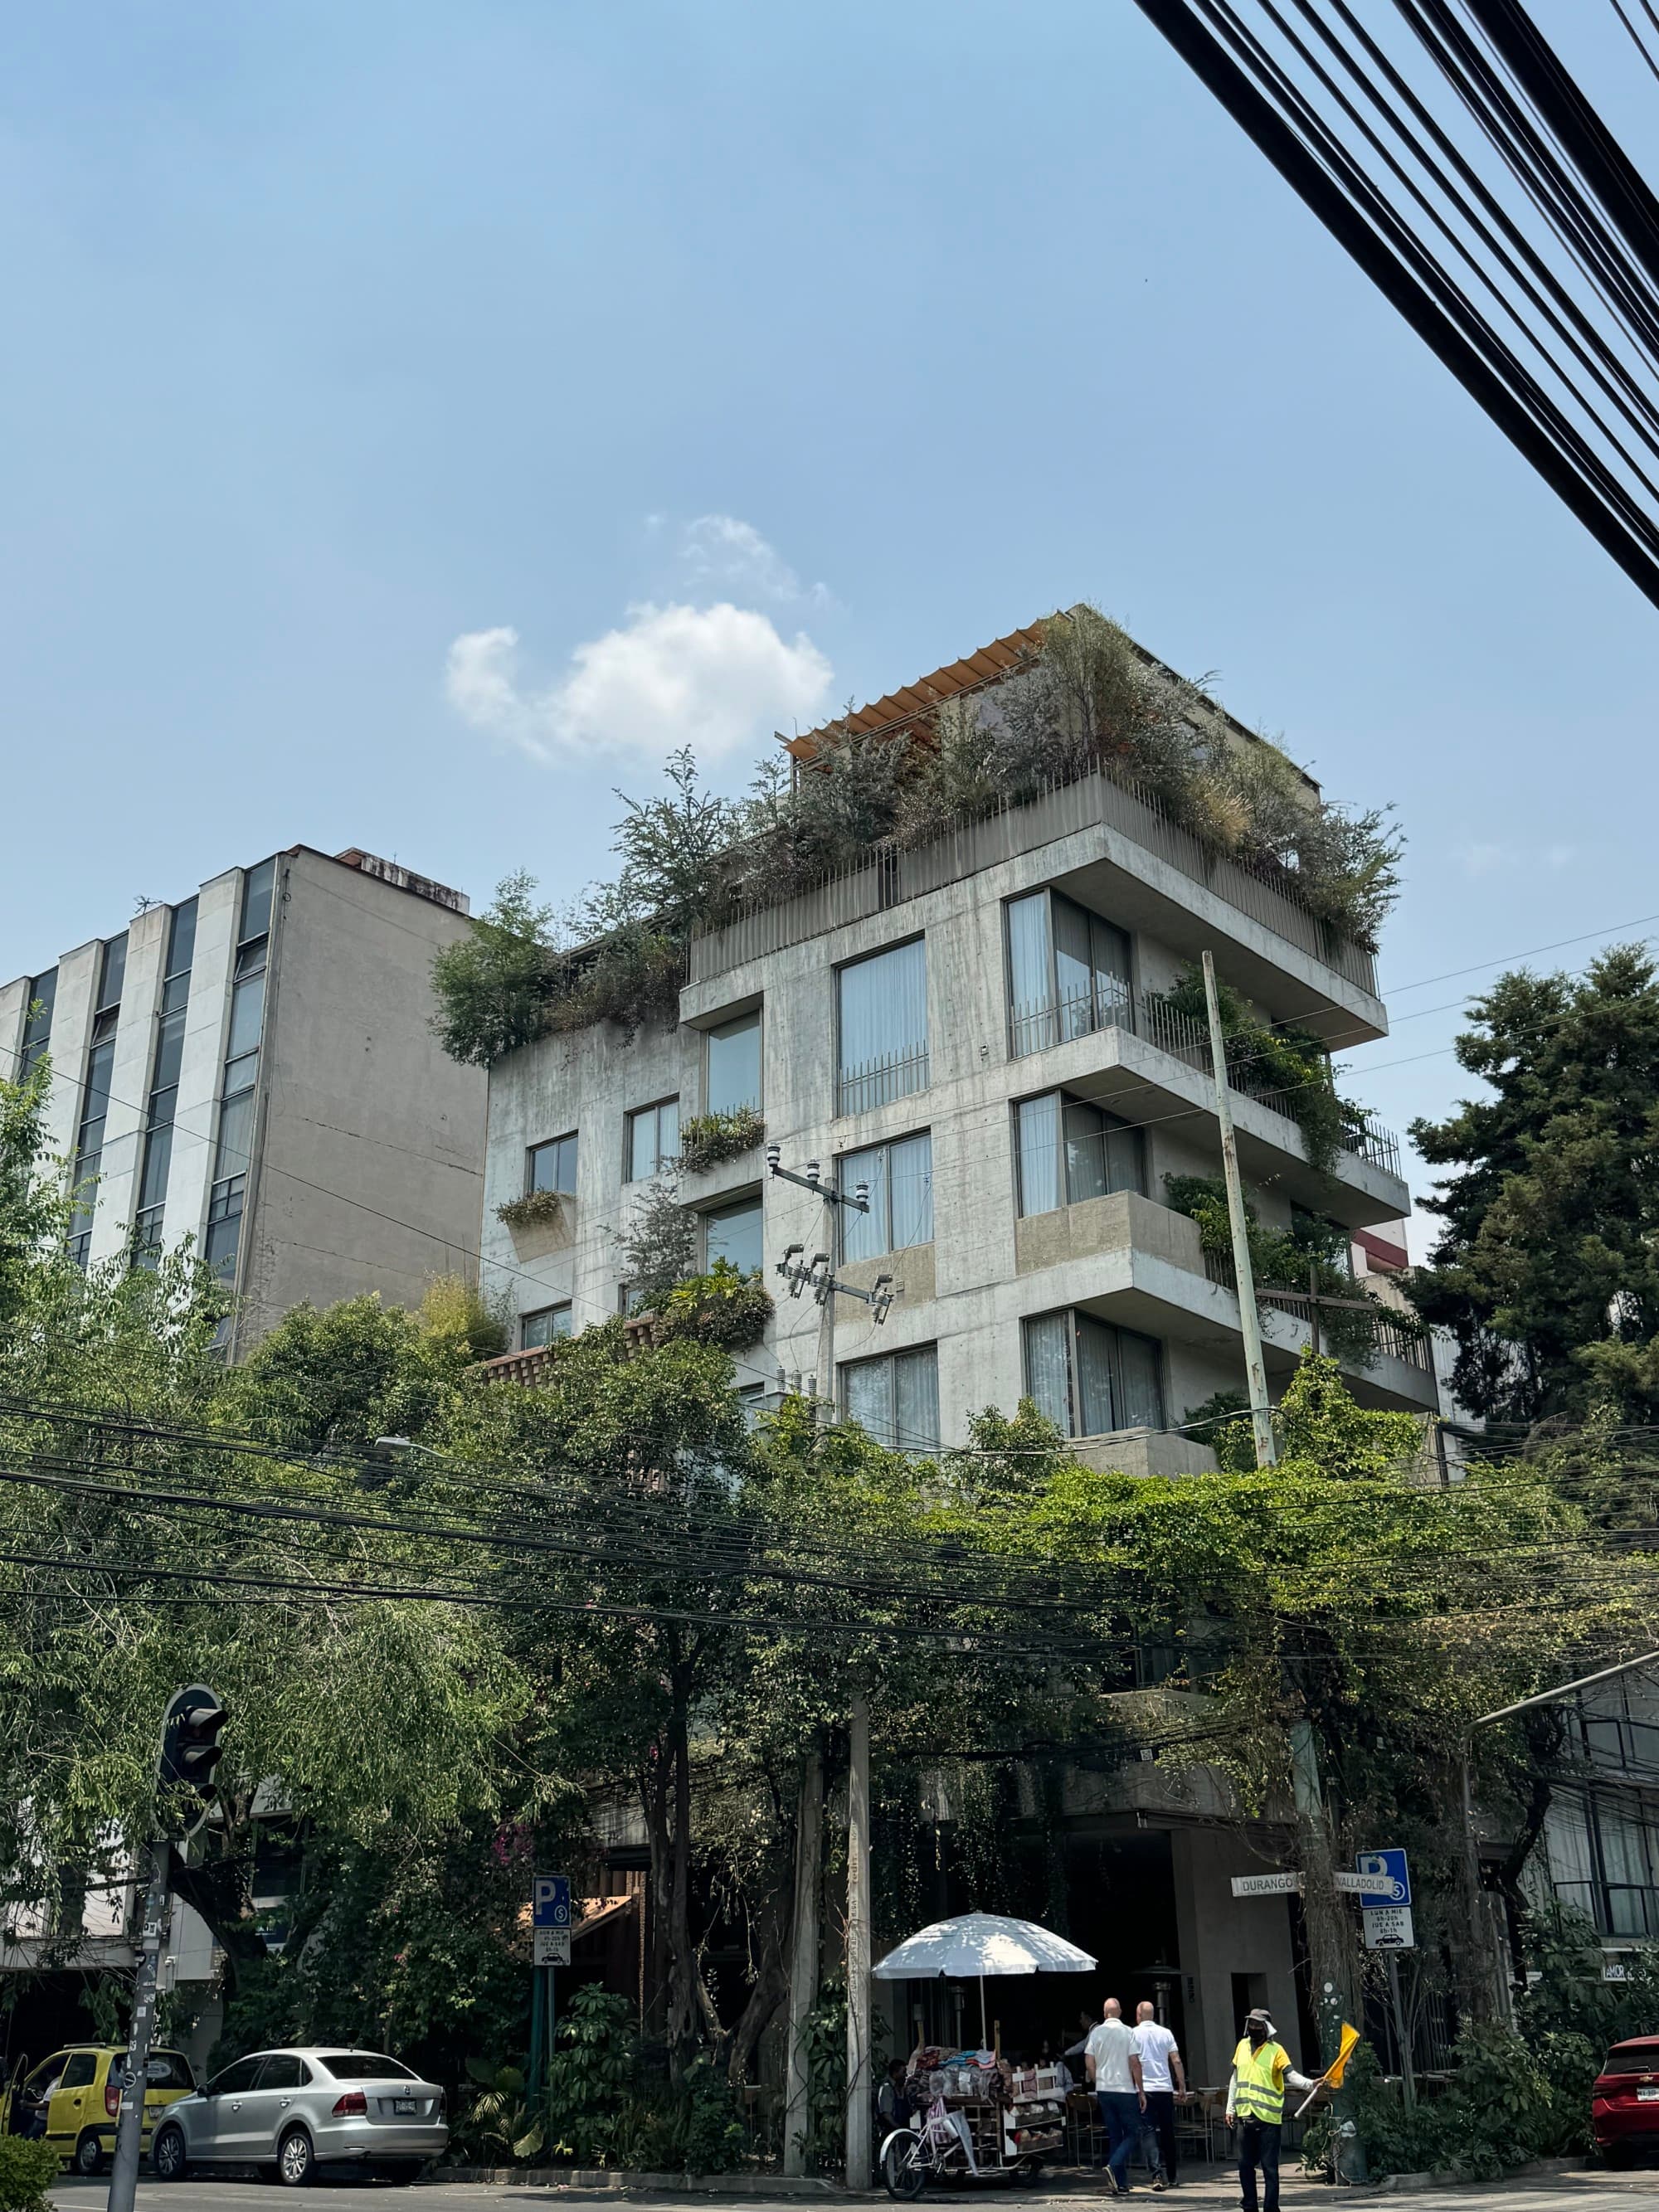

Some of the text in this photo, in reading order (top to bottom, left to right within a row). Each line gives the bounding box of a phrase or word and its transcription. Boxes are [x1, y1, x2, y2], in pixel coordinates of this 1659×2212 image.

[1243, 1877, 1293, 1892] DURANGO
[1338, 1876, 1384, 1890] VALLADOLID
[535, 1880, 556, 1915] P
